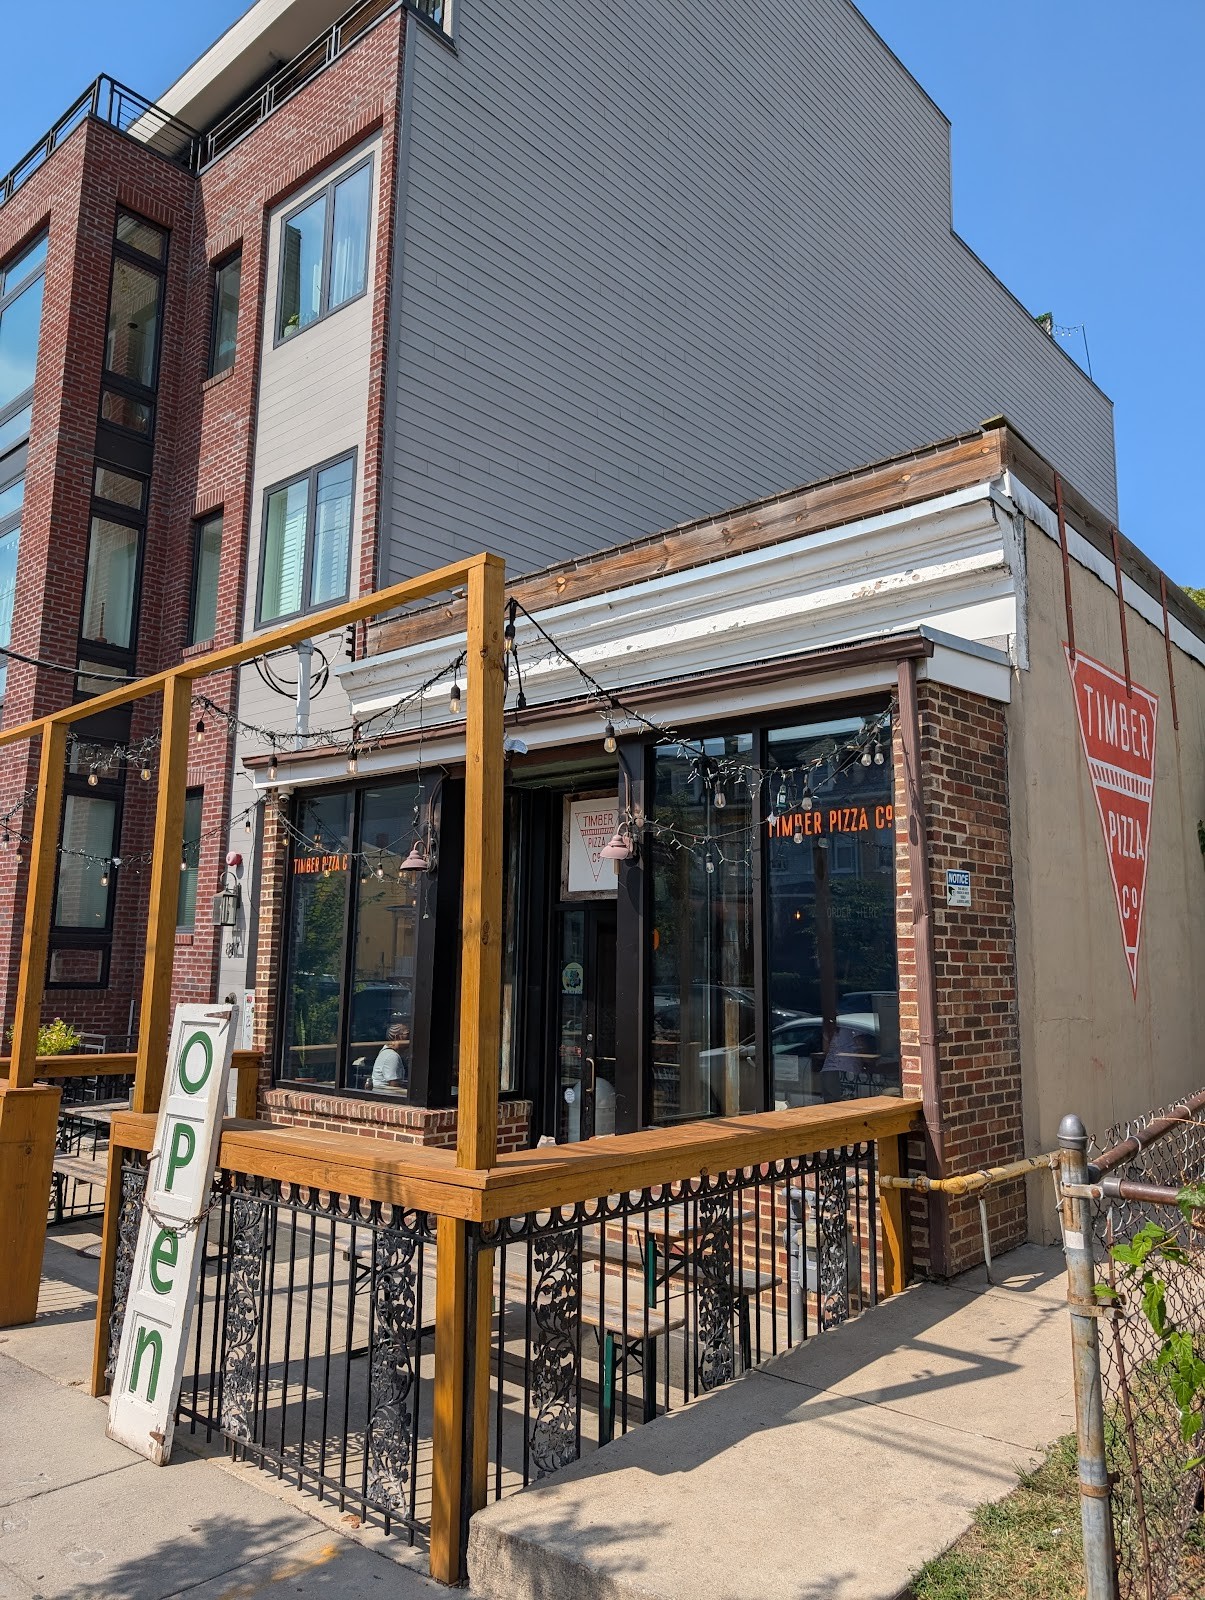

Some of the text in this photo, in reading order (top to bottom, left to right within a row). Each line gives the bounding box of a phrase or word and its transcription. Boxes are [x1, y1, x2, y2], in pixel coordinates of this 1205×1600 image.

[1083, 683, 1150, 761] TIMBER
[583, 813, 614, 827] TIMBER
[768, 811, 822, 838] TIMBER
[829, 807, 869, 833] PIZZA
[588, 836, 606, 848] PIZZA
[1108, 810, 1145, 861] PIZZA
[293, 857, 320, 875] TIMBER
[948, 872, 969, 884] NOTICE
